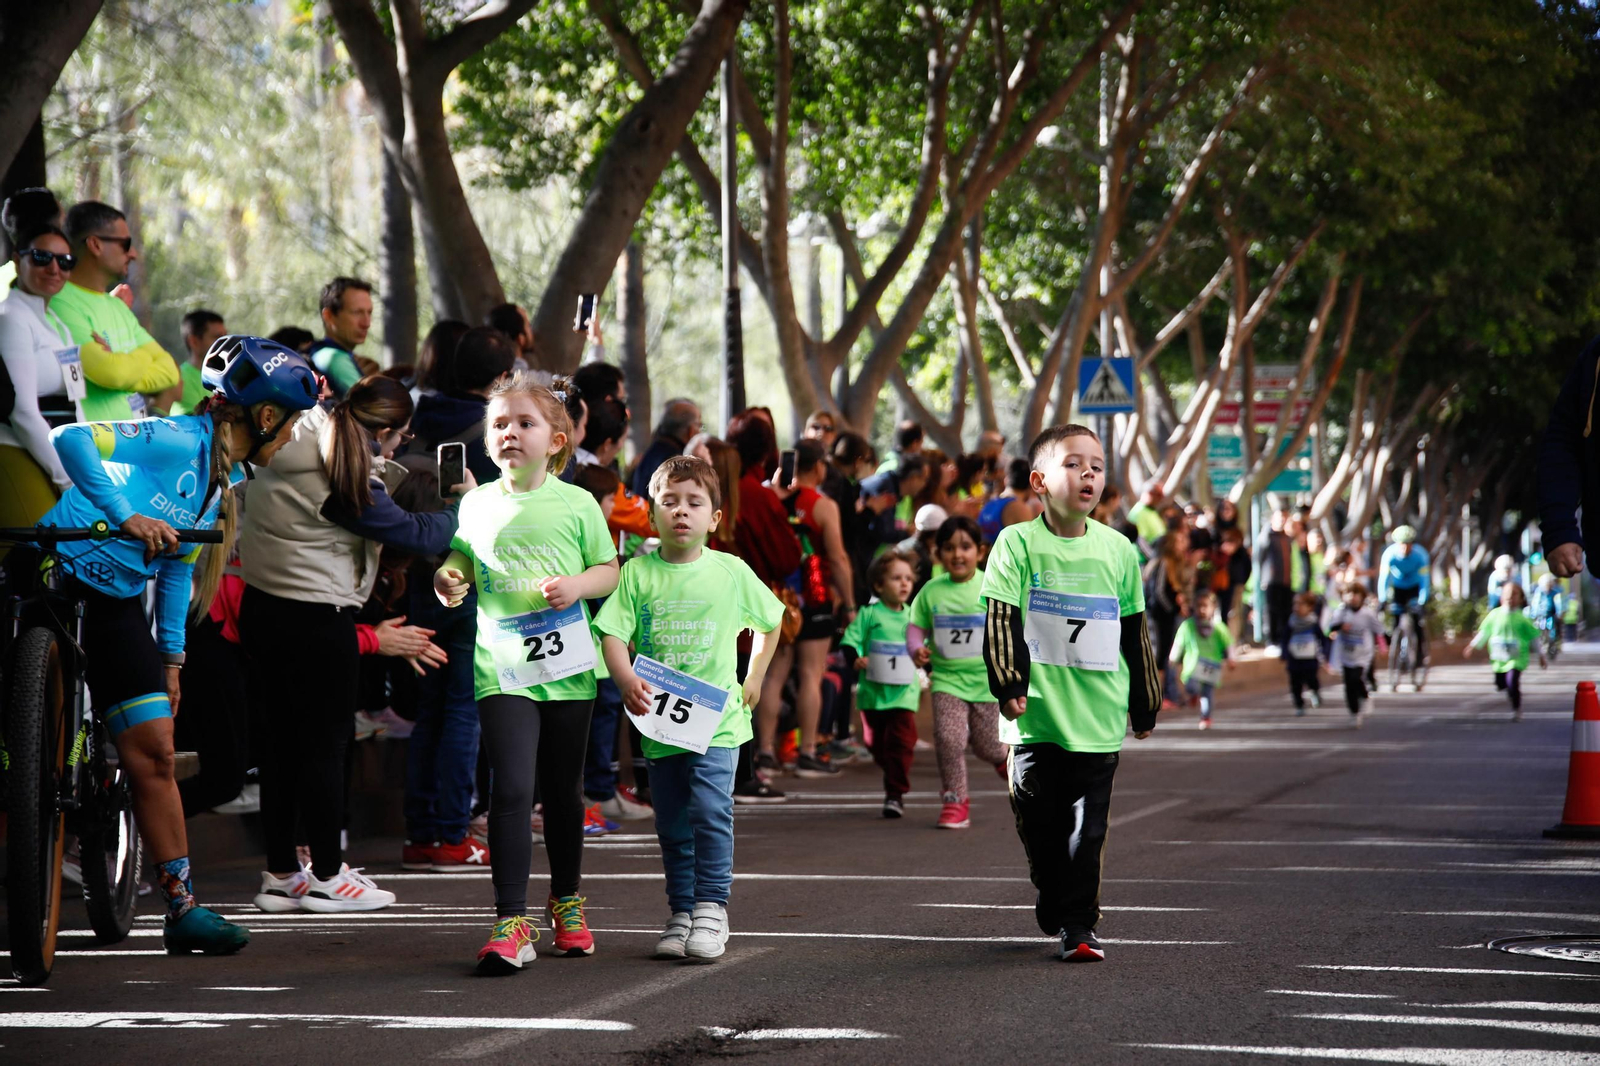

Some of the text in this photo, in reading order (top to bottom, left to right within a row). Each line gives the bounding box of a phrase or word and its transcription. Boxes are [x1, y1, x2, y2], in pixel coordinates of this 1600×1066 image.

[507, 543, 560, 557] marcha
[546, 558, 560, 573] el
[1032, 599, 1054, 608] contra
[1062, 603, 1087, 612] cáncer
[525, 620, 548, 631] cáncer
[652, 618, 717, 631] En marcha
[1066, 618, 1087, 644] 7
[653, 631, 714, 647] contra el
[950, 628, 974, 644] 27
[523, 630, 564, 663] 23
[638, 660, 664, 674] Almería
[888, 655, 897, 670] 1
[636, 667, 657, 680] contra
[665, 678, 687, 691] cáncer
[653, 691, 693, 724] 15
